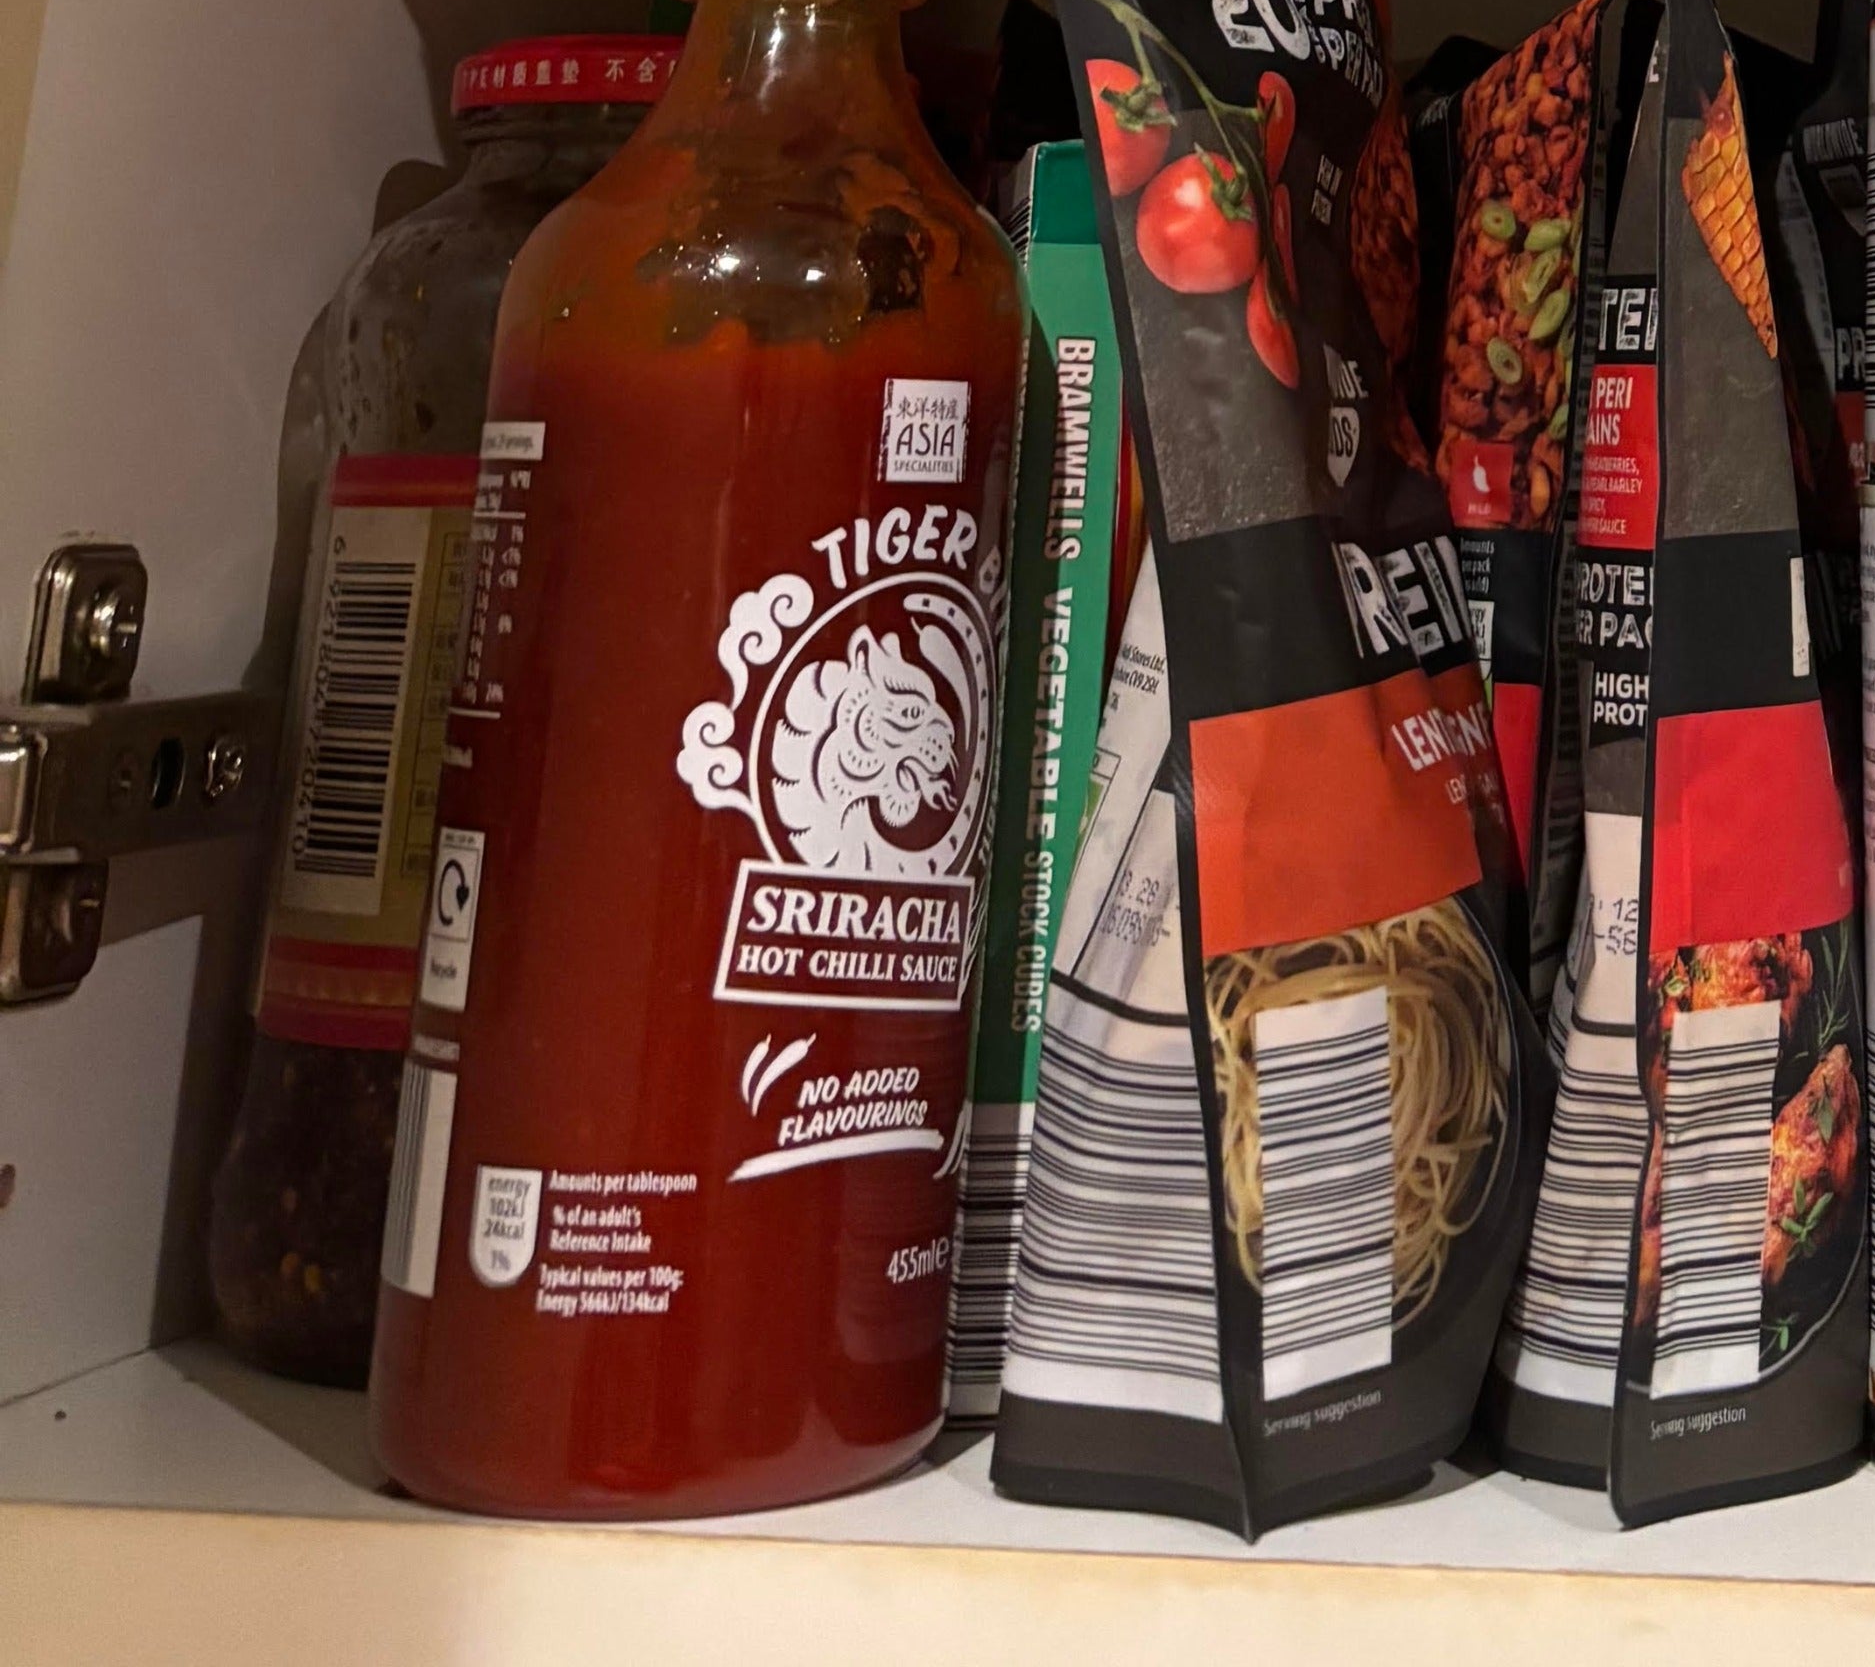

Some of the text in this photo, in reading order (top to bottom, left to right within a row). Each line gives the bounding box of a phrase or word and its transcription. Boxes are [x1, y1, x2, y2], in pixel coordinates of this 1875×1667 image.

[895, 424, 955, 457] ASIA
[811, 505, 977, 589] TIGER
[1012, 337, 1096, 1034] BRAMWELLS VEGETABLE STOCK CUBES
[748, 886, 961, 945] SRIRACHA
[738, 946, 958, 982] HOT CHILLI SAUCE
[799, 1067, 920, 1107] NO ADDED
[778, 1099, 928, 1145] FLAVOURINGS
[888, 1243, 936, 1285] 455ml
[1315, 1388, 1383, 1430] suggestion
